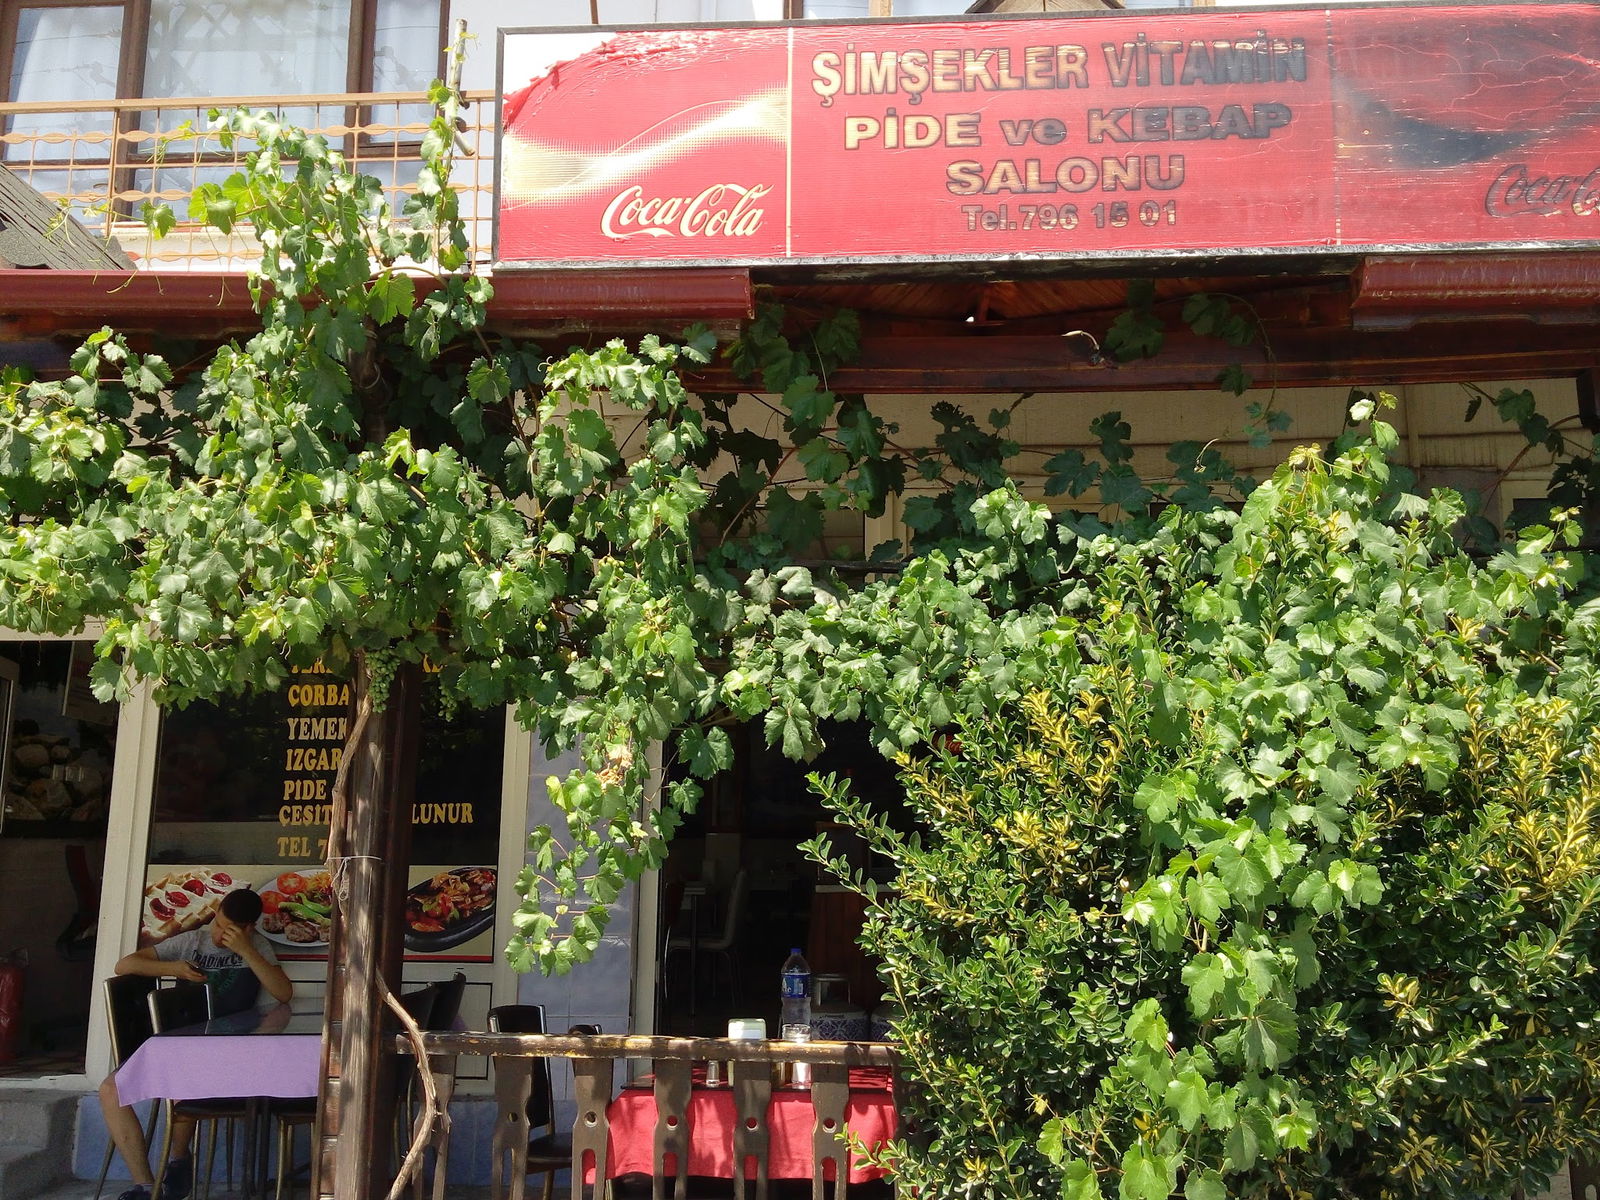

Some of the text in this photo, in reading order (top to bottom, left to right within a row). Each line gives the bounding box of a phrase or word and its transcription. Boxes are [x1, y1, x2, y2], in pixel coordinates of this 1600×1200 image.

[811, 29, 1306, 108] ŞİMŞEKLER VİTAMİN
[844, 103, 1292, 150] PİDE ve KEBAP
[945, 155, 1185, 194] SALONU
[600, 183, 775, 238] Coca-Cola
[1138, 200, 1177, 227] 01
[285, 747, 342, 771] IZGAR
[411, 803, 474, 824] LUNUR
[277, 837, 311, 857] TEL
